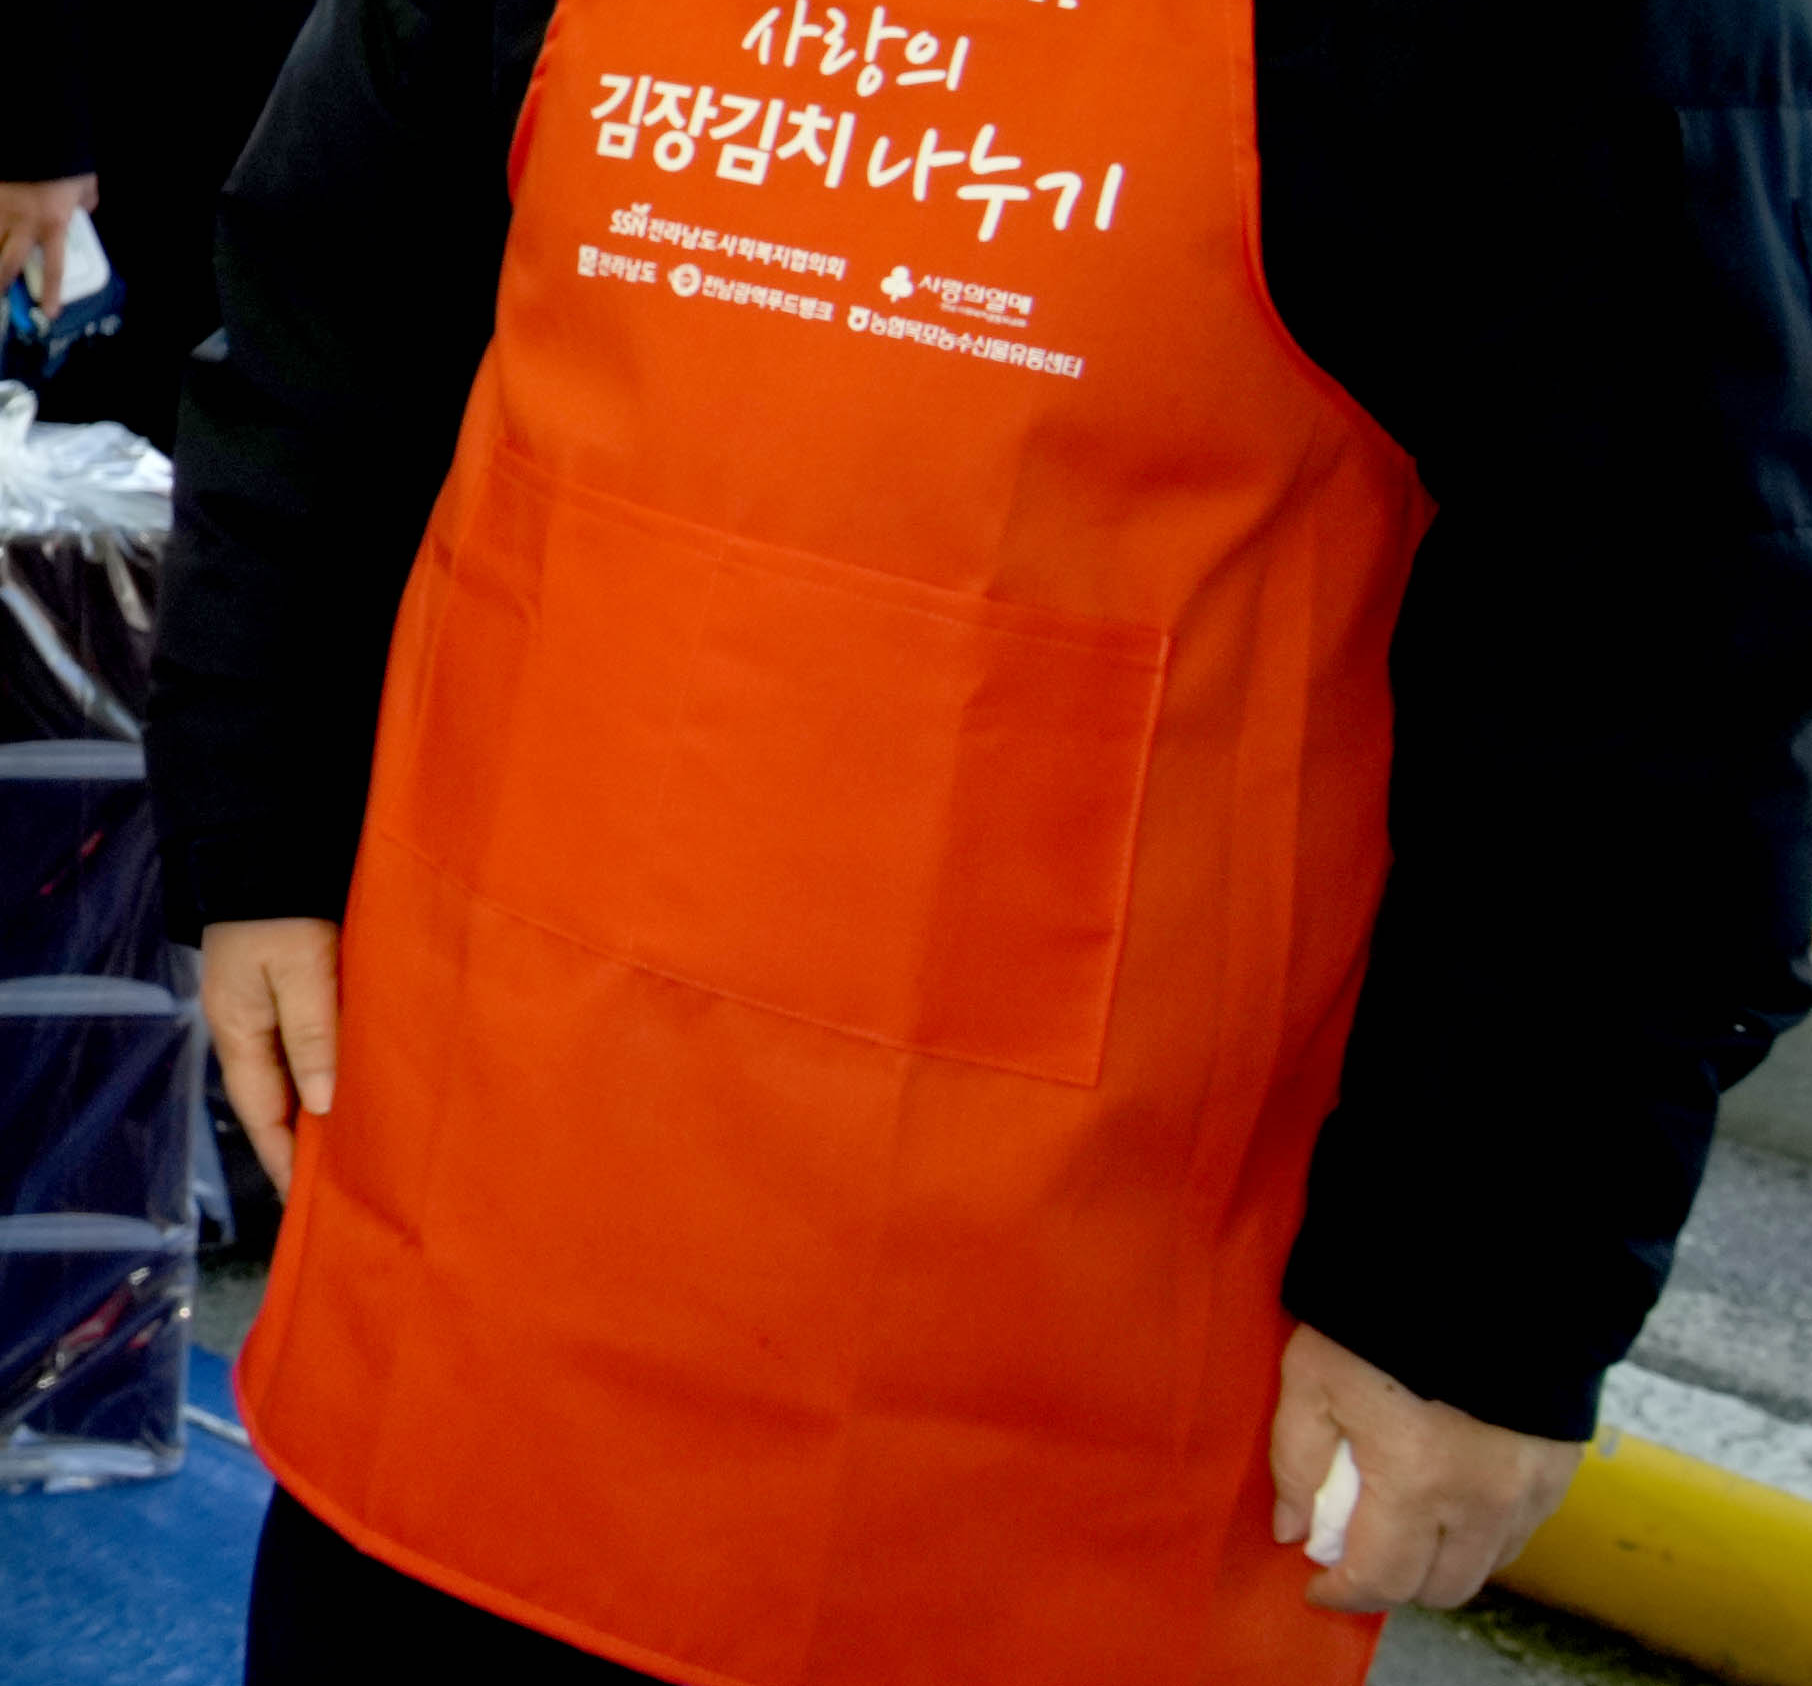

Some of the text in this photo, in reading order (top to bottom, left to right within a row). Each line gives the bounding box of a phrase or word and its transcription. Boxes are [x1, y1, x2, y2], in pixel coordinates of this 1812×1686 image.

[590, 72, 1124, 243] 김장김치 나누기
[917, 274, 1034, 315] 사랑의열매
